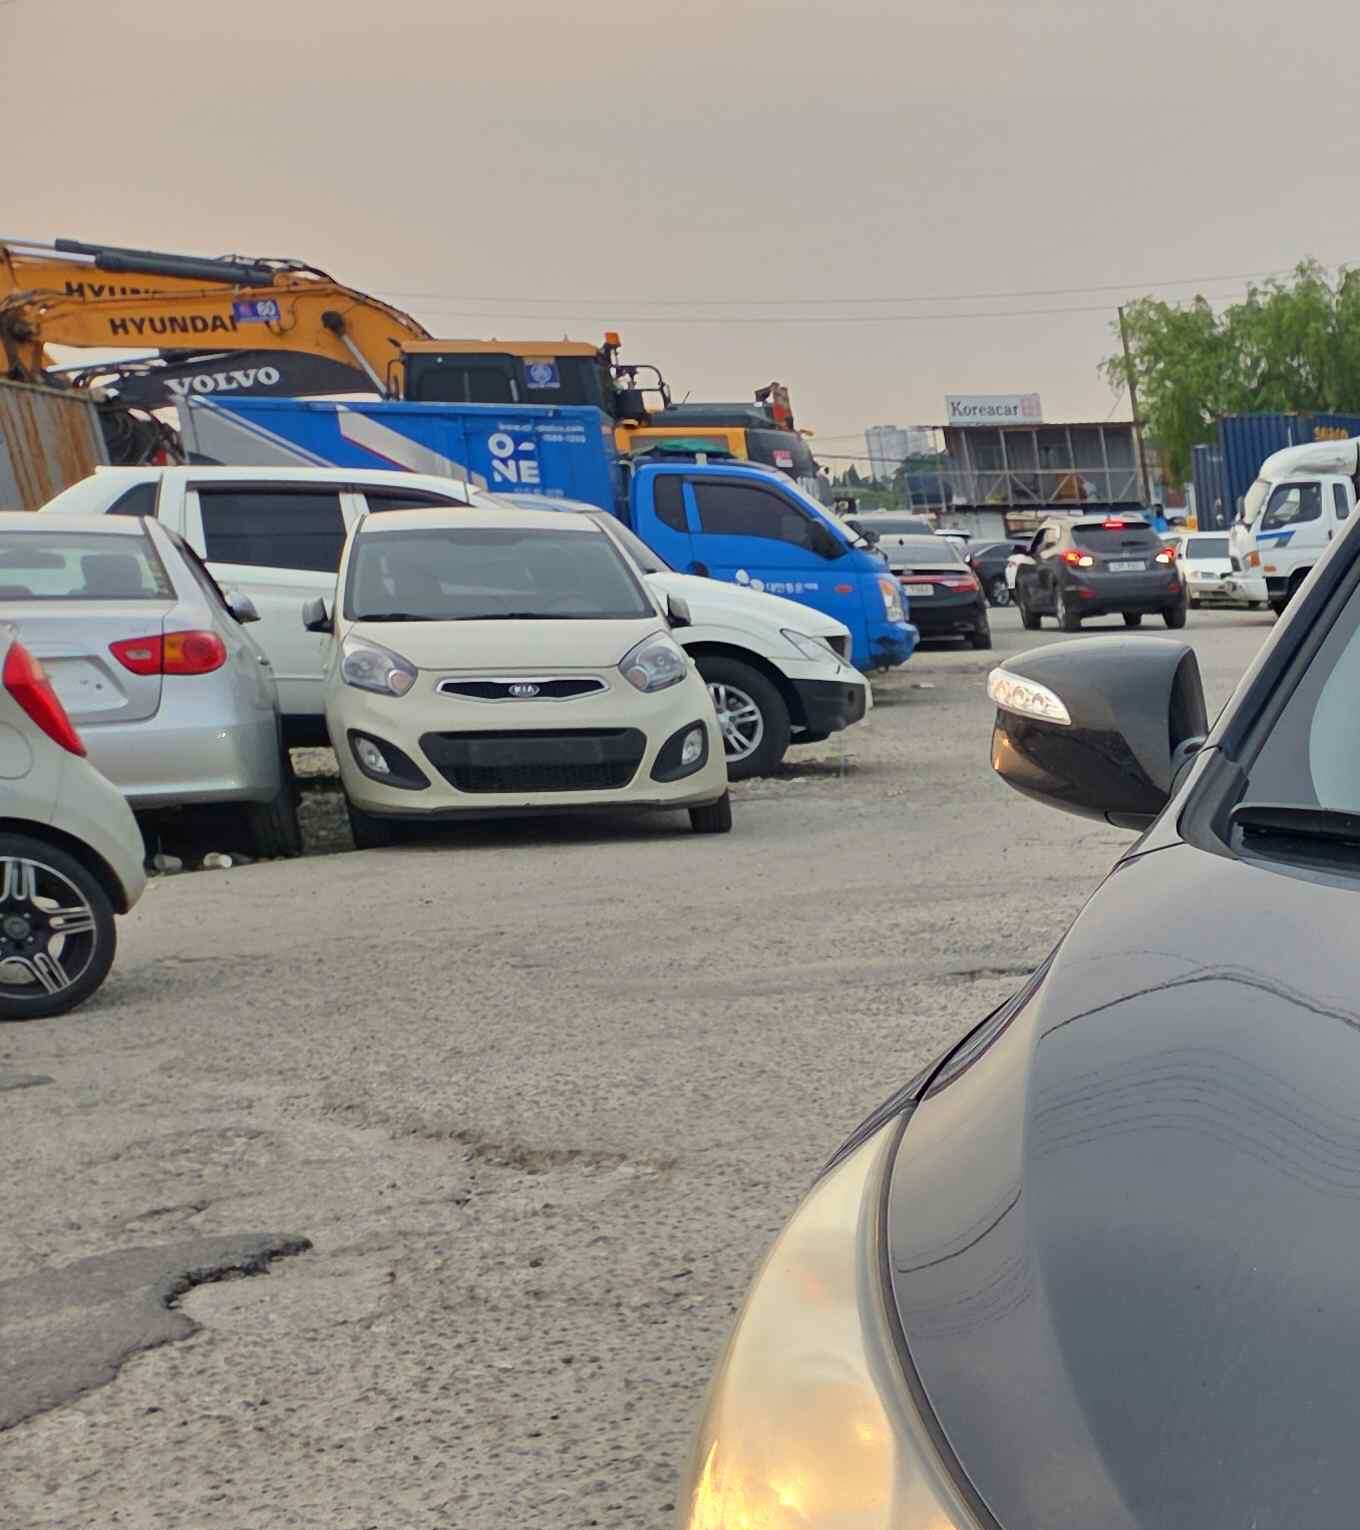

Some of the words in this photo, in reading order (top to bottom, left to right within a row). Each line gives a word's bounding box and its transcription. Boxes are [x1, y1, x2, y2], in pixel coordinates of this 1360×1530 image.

[163, 366, 281, 397] VOLVO
[951, 401, 1018, 417] Koreacar
[491, 459, 541, 484] NE
